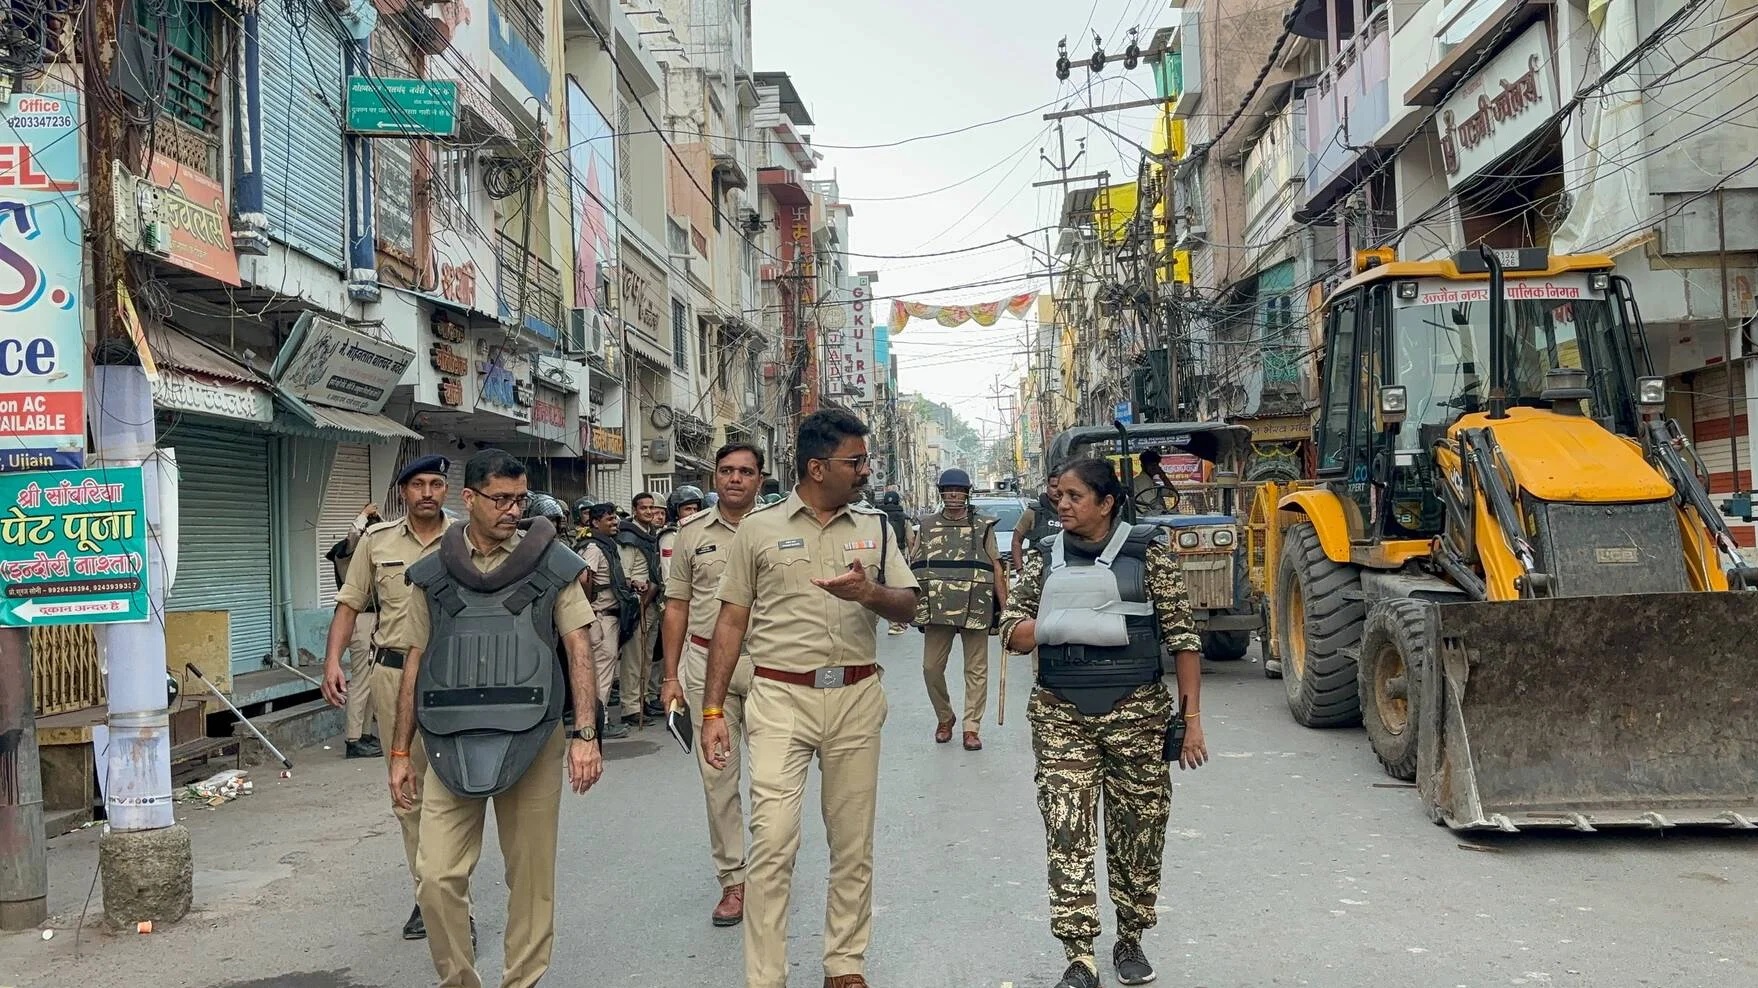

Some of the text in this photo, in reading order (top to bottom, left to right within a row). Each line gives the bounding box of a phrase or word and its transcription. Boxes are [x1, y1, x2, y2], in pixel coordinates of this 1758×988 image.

[19, 100, 60, 112] Office
[1545, 282, 1580, 299] निगम
[852, 287, 865, 353] GOKUL
[22, 395, 47, 413] AC
[9, 453, 54, 470] Ujjain
[17, 478, 124, 508] श्री साँवरिया
[0, 507, 136, 552] पेट पूजा
[110, 600, 120, 610] है
